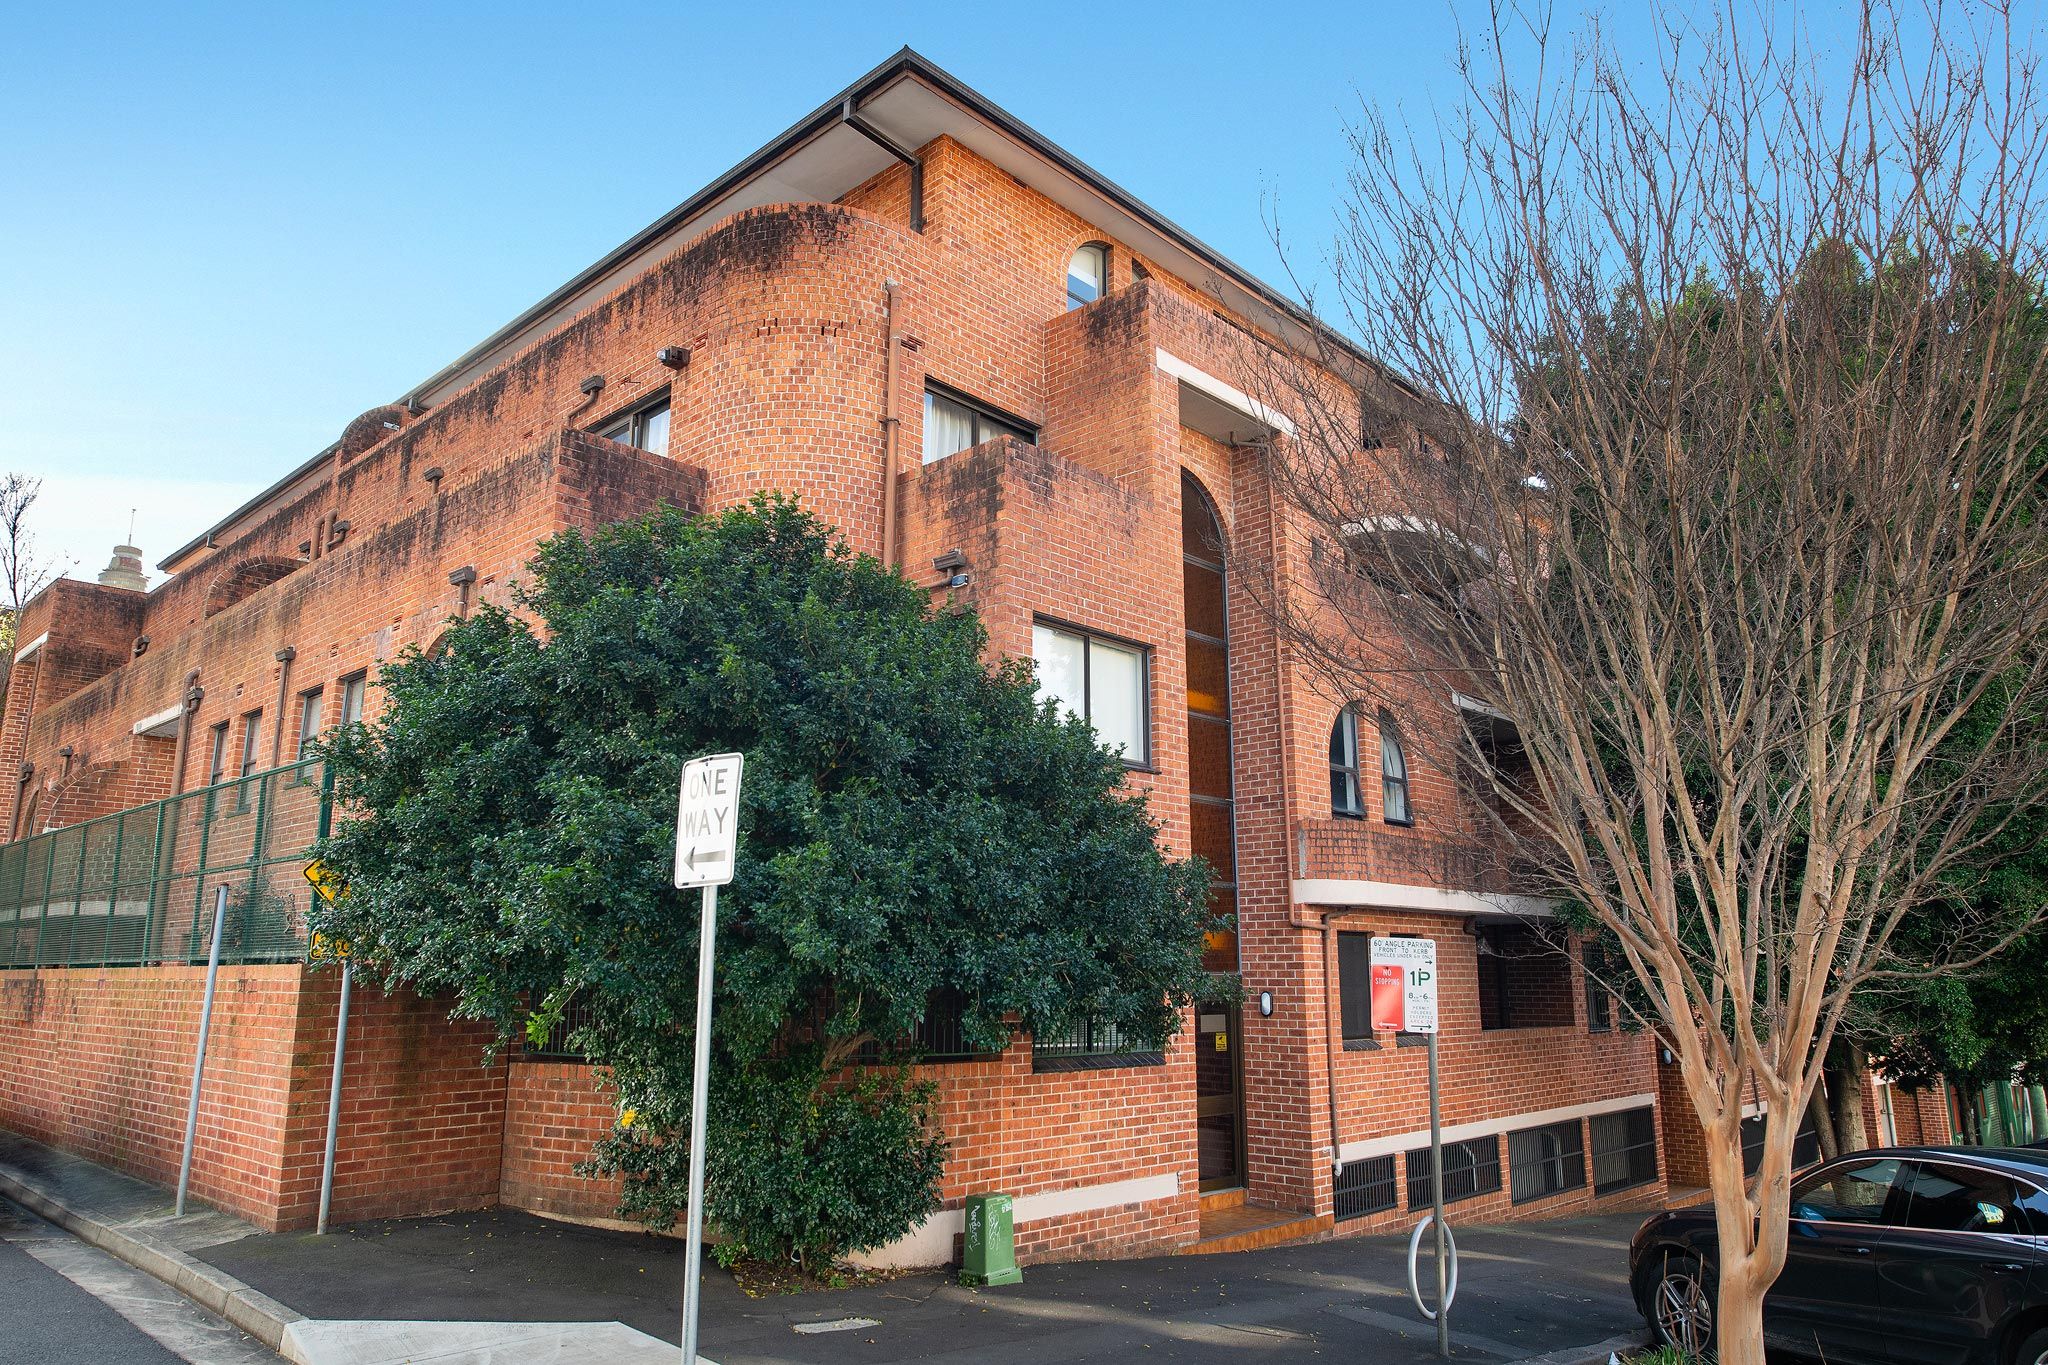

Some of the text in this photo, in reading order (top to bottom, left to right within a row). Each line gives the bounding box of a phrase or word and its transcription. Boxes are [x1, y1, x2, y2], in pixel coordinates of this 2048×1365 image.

[689, 767, 728, 800] ONE
[685, 806, 729, 838] WAY
[1384, 940, 1405, 948] ANGLE
[1407, 941, 1434, 949] PARKING
[1382, 968, 1392, 976] NO
[1409, 970, 1431, 986] 1P
[1375, 977, 1400, 985] STOPPING
